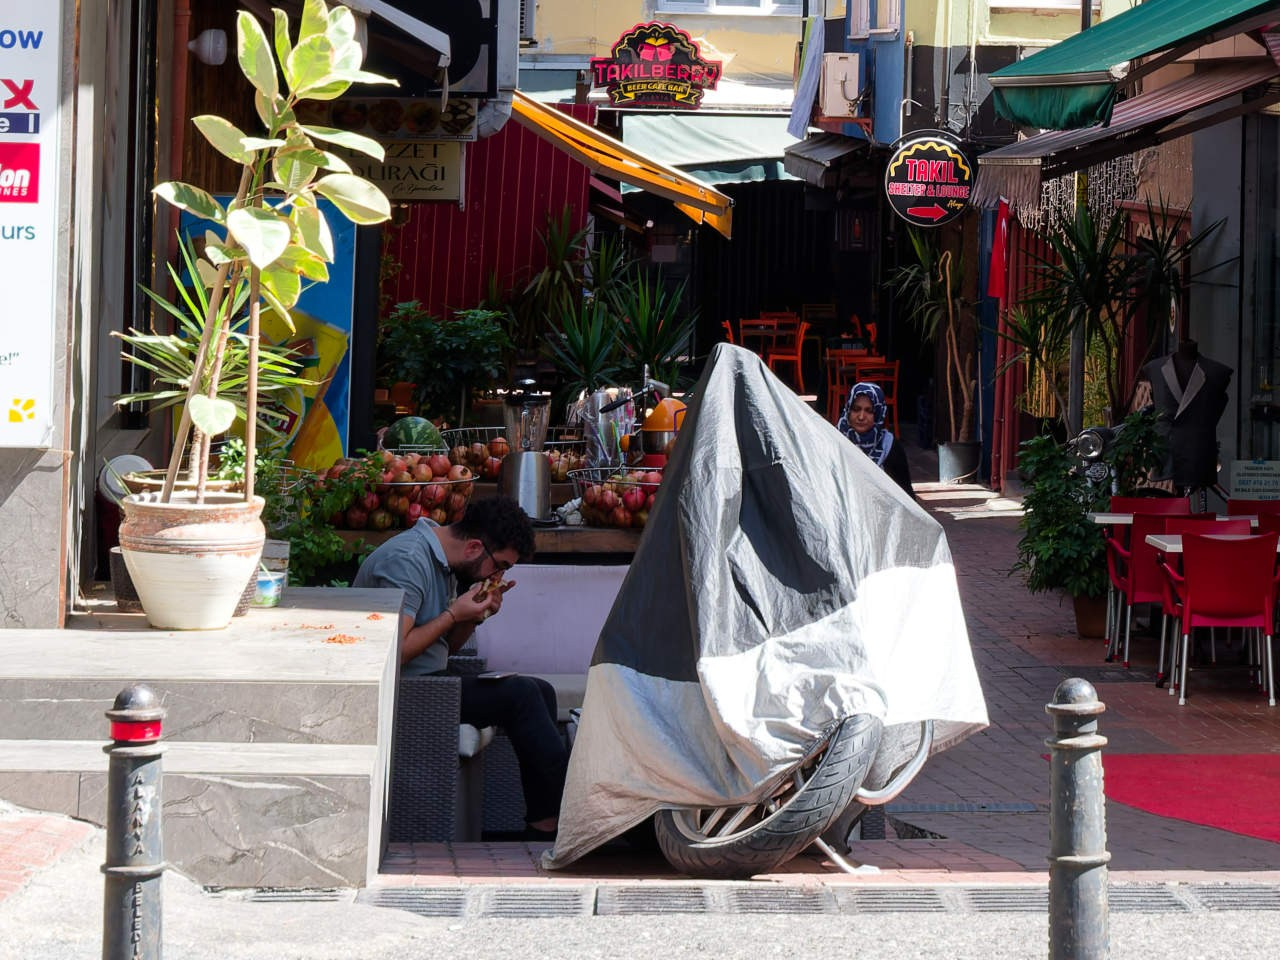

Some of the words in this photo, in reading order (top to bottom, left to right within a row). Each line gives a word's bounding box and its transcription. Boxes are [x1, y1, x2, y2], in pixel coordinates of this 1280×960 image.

[595, 62, 719, 85] TAKILBERRY
[906, 158, 959, 183] TAKIL
[889, 181, 926, 197] SHELTER
[926, 183, 936, 197] &
[936, 185, 970, 199] LOUNGE
